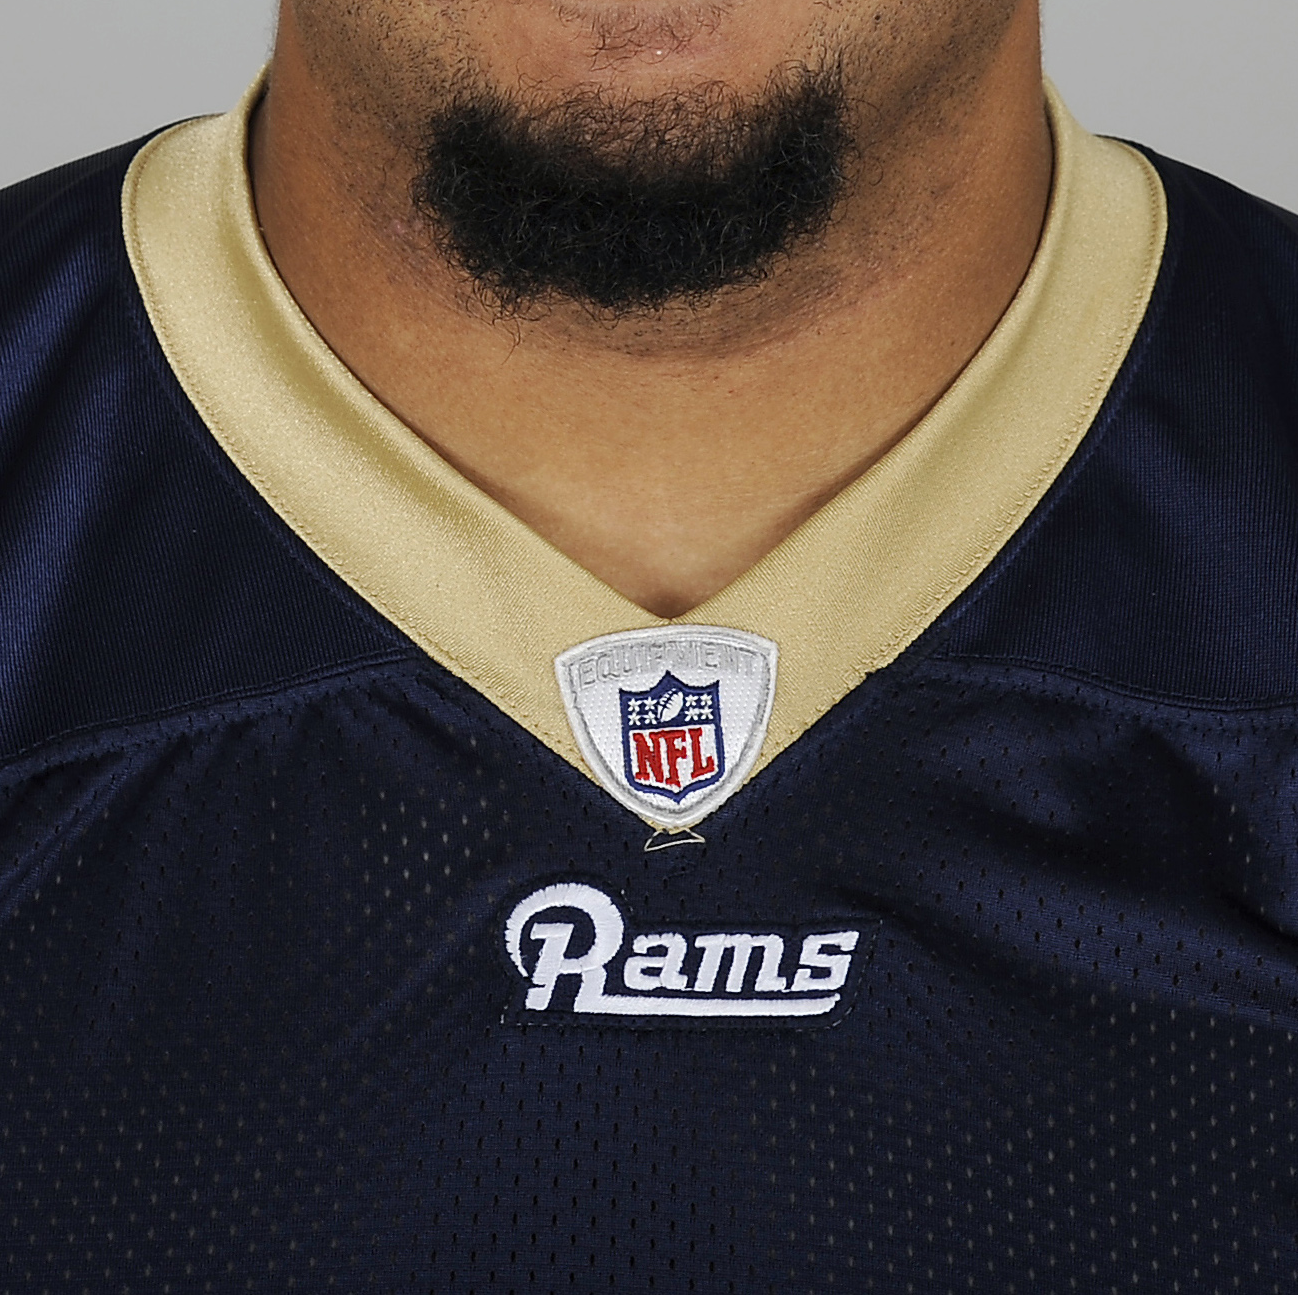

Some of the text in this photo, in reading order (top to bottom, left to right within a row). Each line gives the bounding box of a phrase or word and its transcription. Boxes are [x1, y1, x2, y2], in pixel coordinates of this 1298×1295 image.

[577, 639, 759, 689] EQUIPMENT
[632, 727, 715, 788] NFL
[504, 882, 860, 1017] Rams
